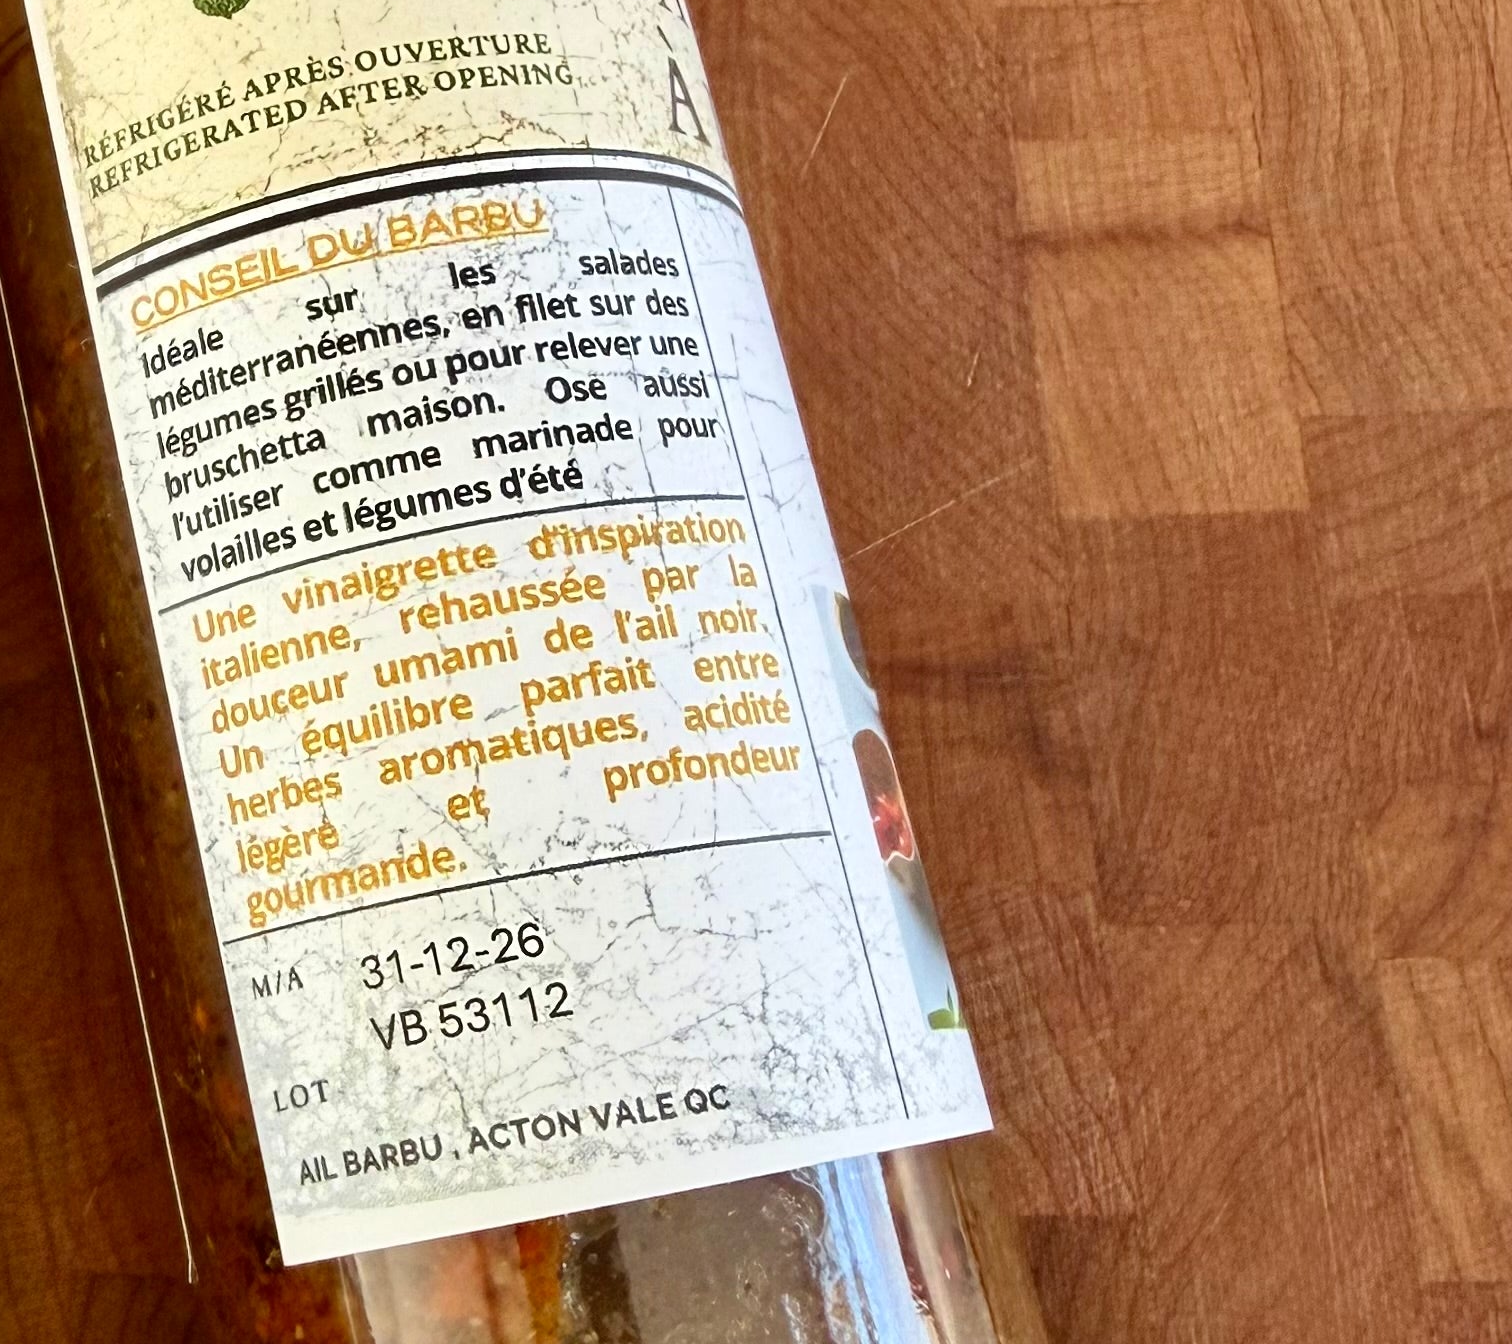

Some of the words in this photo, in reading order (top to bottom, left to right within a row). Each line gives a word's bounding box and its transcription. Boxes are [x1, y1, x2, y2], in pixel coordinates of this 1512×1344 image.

[82, 78, 234, 168] RÉFRIGÉRÉ
[242, 56, 345, 106] APRÈS
[354, 33, 552, 72] OUVERTURE
[88, 100, 308, 198] REFRIGERATED
[316, 75, 428, 120] AFTER
[432, 59, 573, 93] OPENING
[657, 25, 711, 147] À
[131, 246, 298, 328] CONSEIL
[306, 223, 375, 268] DU
[389, 199, 546, 249] BARBU
[305, 289, 359, 322] sur
[449, 260, 496, 290] les
[578, 251, 680, 277] salades
[461, 304, 506, 330] en
[516, 289, 581, 325] filet
[589, 291, 635, 316] sur
[645, 287, 689, 317] des
[156, 397, 278, 459] légumes
[284, 361, 383, 423] grillés
[391, 357, 437, 386] ou
[444, 345, 525, 388] pour
[535, 330, 641, 366] relever
[650, 332, 699, 358] une
[163, 424, 327, 502] bruschetta
[367, 391, 506, 438] maison.
[545, 372, 607, 403] Ose
[644, 371, 710, 398] aussi
[313, 443, 442, 494] comme
[472, 411, 634, 457] marinade
[657, 416, 719, 446] pour
[180, 520, 297, 581] volailles
[303, 514, 338, 541] et
[344, 473, 491, 533] légumes
[191, 601, 257, 644] Une
[282, 538, 496, 615] vinaigrette
[202, 620, 361, 690] italienne,
[399, 564, 607, 635] rehaussée
[641, 562, 700, 600] par
[730, 554, 758, 590] la
[210, 673, 347, 734] douceur
[376, 630, 519, 688] umami
[544, 615, 594, 653] de
[219, 746, 266, 781] Un
[302, 687, 474, 760] équilibre
[520, 656, 656, 717] parfait
[693, 648, 780, 684] entre
[227, 768, 343, 826] herbes
[380, 714, 650, 785] aromatiques,
[684, 688, 791, 732] acidité
[447, 784, 489, 822] et
[604, 738, 800, 804] profondeur
[246, 840, 467, 929] gourmande.
[250, 967, 305, 1001] M/A
[360, 920, 544, 992] 31-12-26
[370, 1004, 429, 1052] VB
[439, 981, 574, 1038] 53112
[272, 1078, 330, 1114] LOT
[299, 1154, 338, 1187] AIL
[343, 1134, 444, 1177] BARBU
[467, 1110, 582, 1155] ACTON
[588, 1092, 674, 1130] VALE
[684, 1084, 730, 1114] QC
